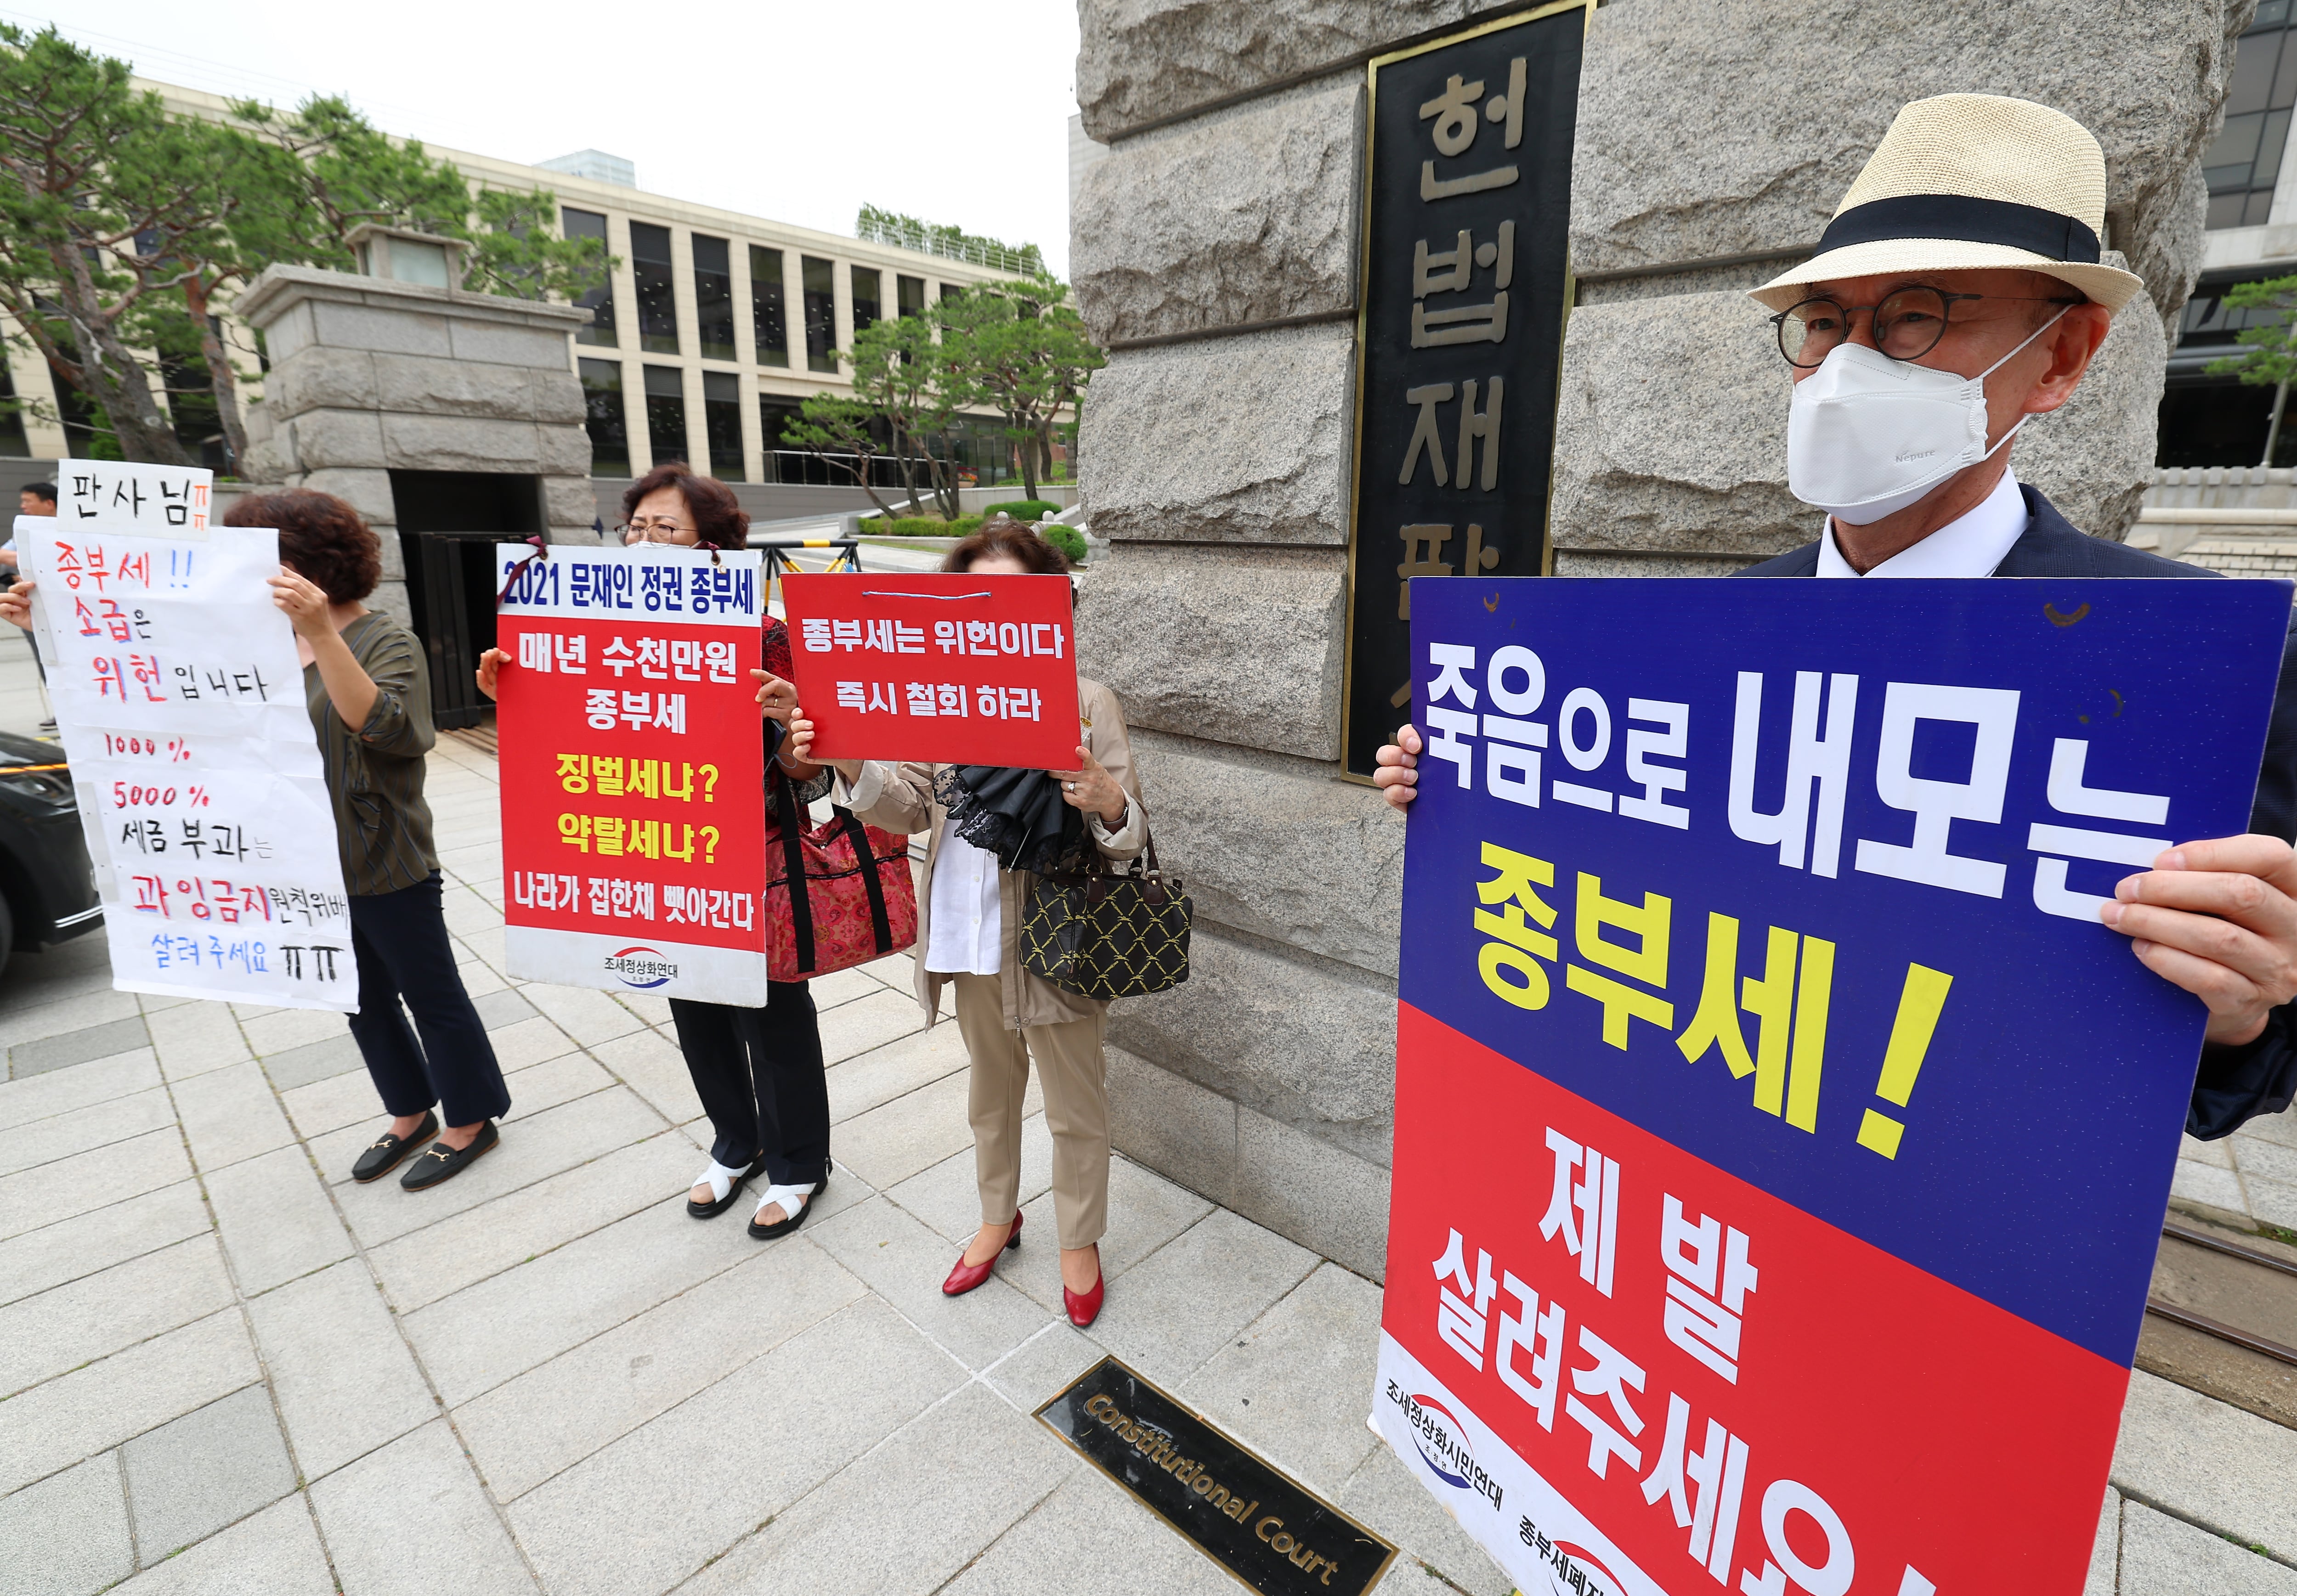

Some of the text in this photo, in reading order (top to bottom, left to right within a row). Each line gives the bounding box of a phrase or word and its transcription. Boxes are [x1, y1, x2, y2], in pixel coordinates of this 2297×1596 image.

[1389, 57, 1528, 746] 헌법재판
[1895, 450, 1935, 462] Nepure
[55, 541, 151, 592] 종부세
[504, 560, 753, 615] 2021 문재인 정권 종부세
[518, 632, 736, 684] 매년 수천만원
[801, 618, 1064, 659] 종부세는 위헌이다
[585, 688, 687, 735] 종부세
[835, 681, 1042, 722] 즉시 철회 하라
[555, 753, 719, 803] 징벌세냐?
[1426, 641, 2174, 925] 죽음으로 내모는
[557, 812, 720, 864] 약탈세냐?
[513, 871, 755, 932] 나라가 집한채 뺏아간다
[604, 957, 678, 979] 조세정상화연대
[1474, 840, 1836, 1135] 종부세
[1386, 1378, 1504, 1513] 조세정상화시민연대
[1085, 1393, 1341, 1586] Constitutional Court
